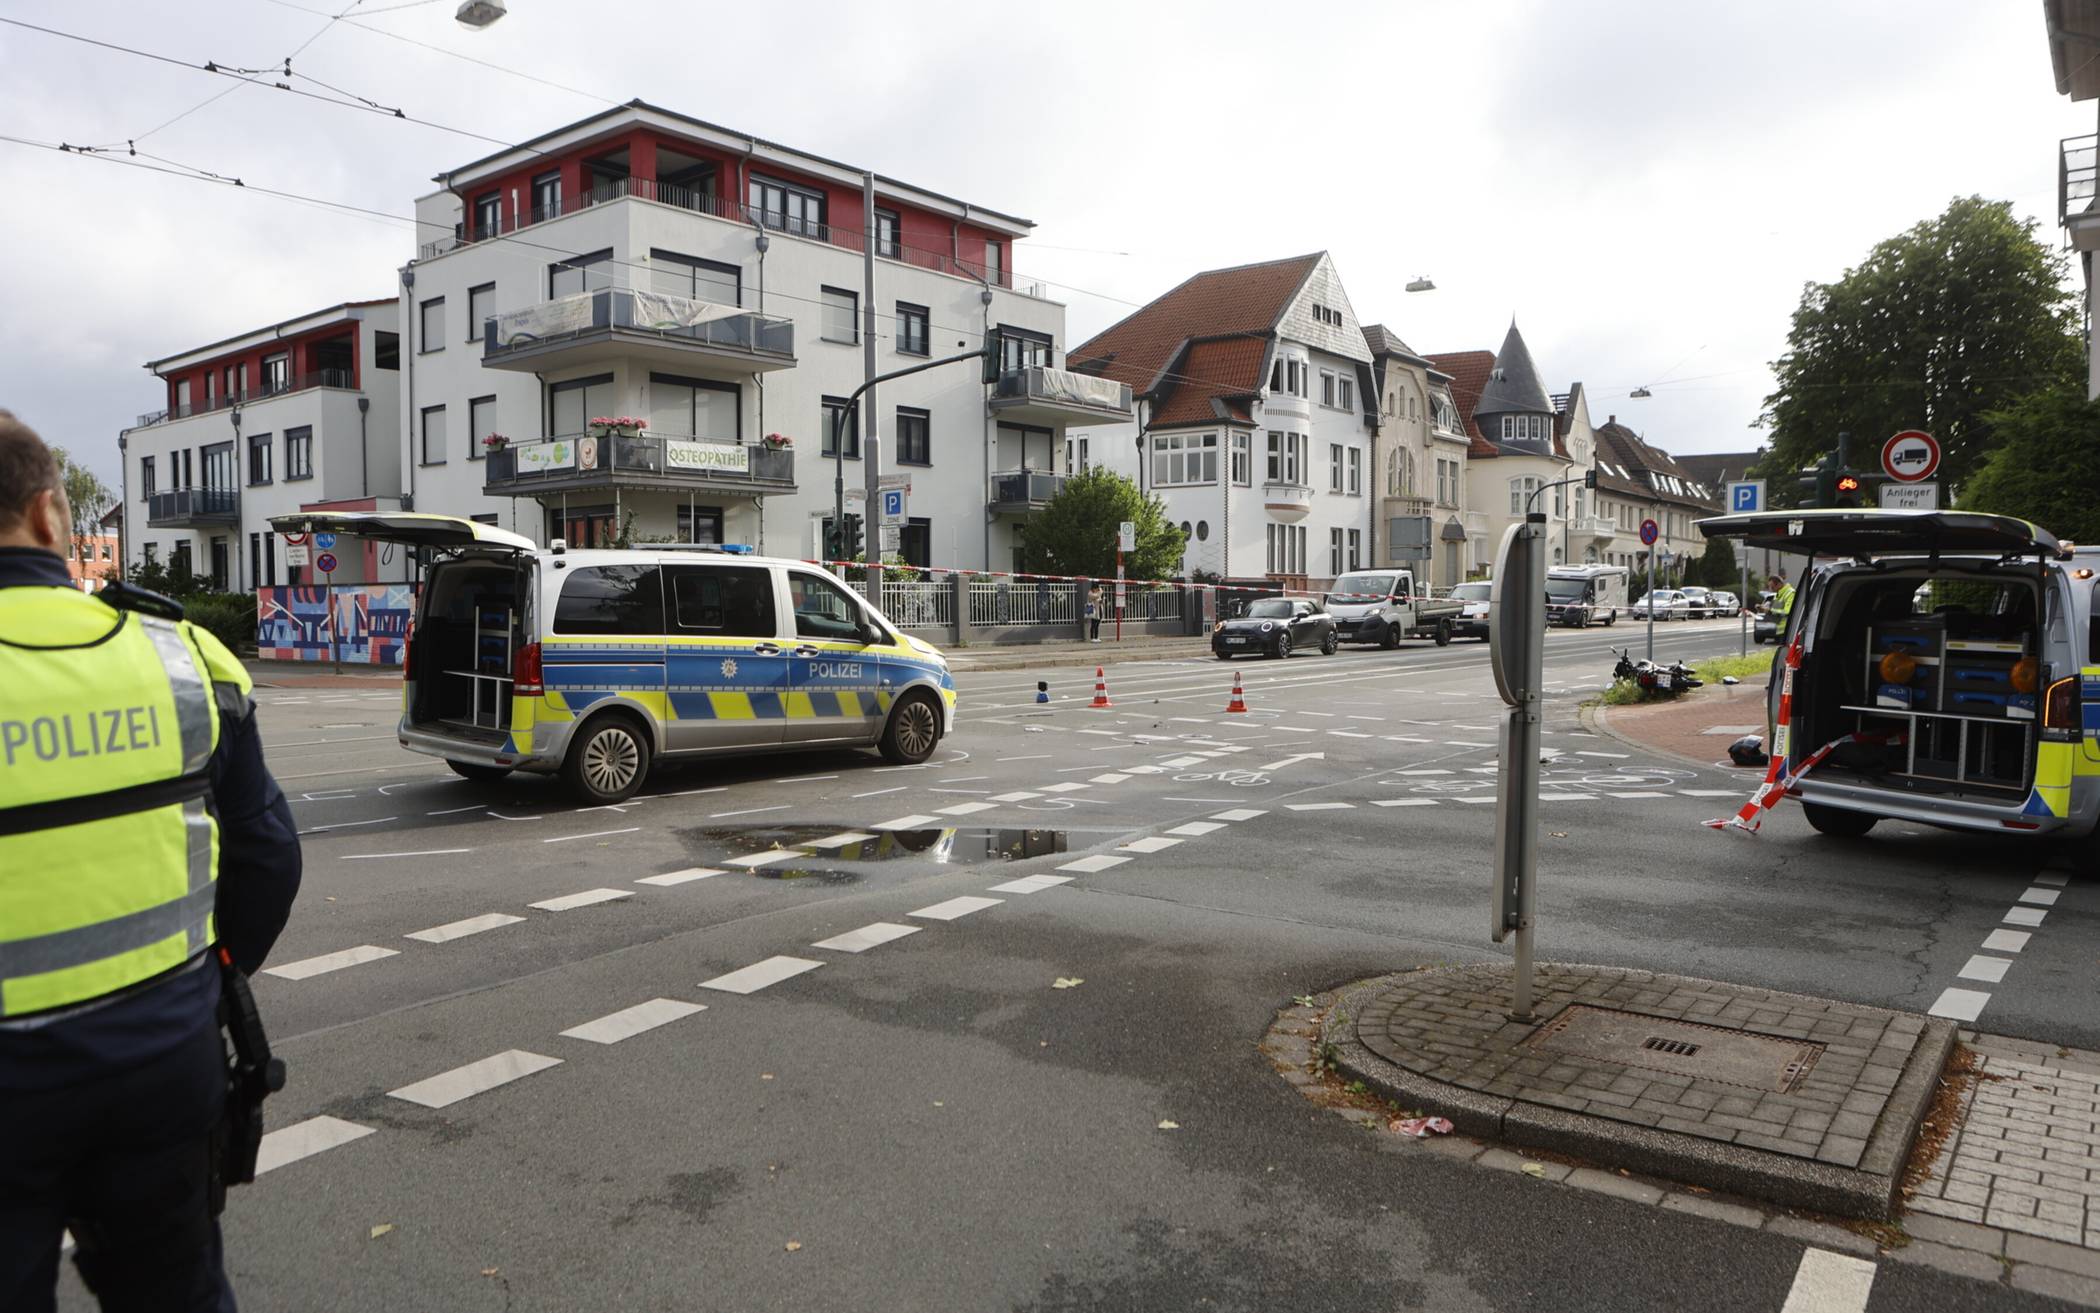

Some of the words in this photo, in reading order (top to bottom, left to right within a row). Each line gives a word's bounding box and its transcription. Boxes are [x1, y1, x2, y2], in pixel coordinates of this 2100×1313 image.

[669, 448, 746, 466] OSTEOPATHIE
[1737, 487, 1752, 505] P
[1887, 488, 1931, 498] Anlieger
[888, 495, 898, 512] P
[1900, 498, 1918, 508] frei
[809, 662, 861, 678] POLIZEI
[1, 705, 161, 766] POLIZEI
